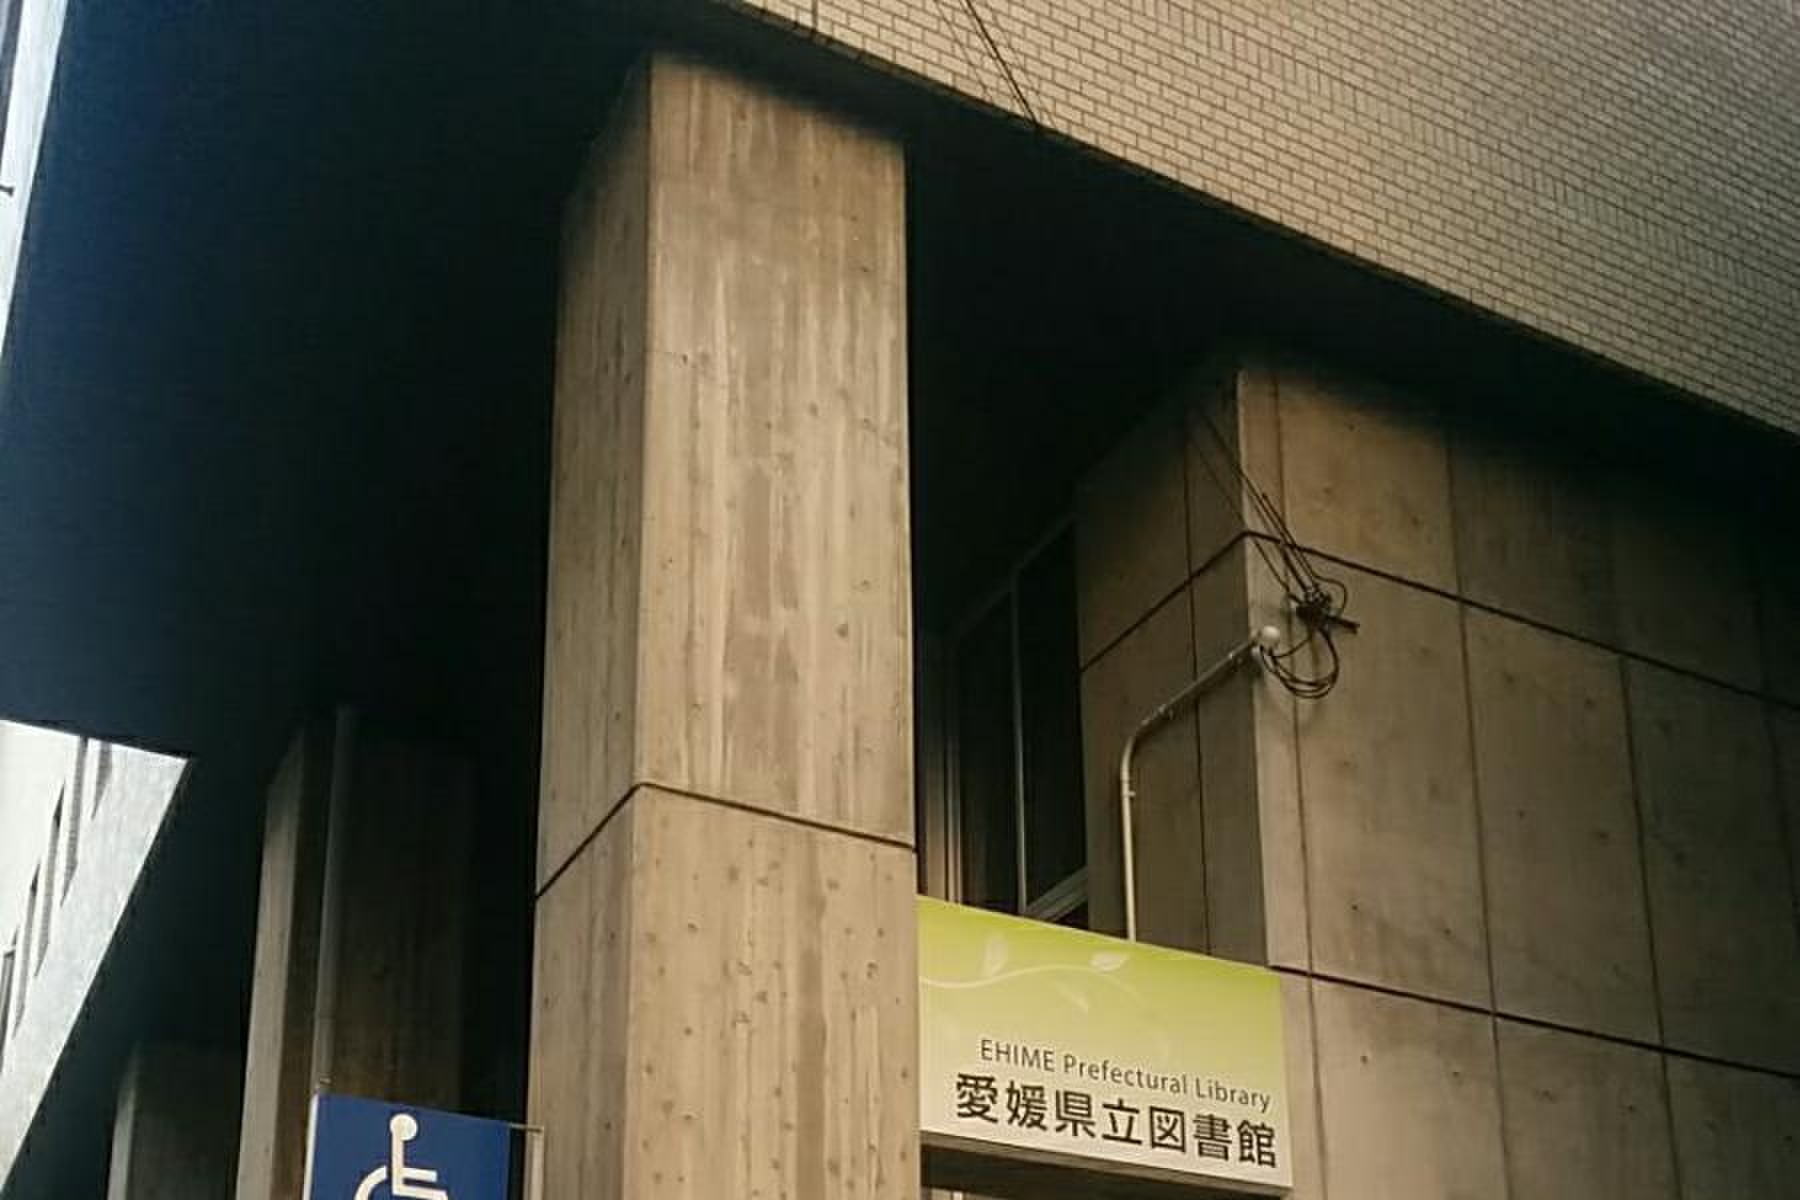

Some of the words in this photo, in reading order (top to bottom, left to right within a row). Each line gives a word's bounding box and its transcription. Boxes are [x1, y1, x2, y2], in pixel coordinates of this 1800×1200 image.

[980, 1038, 1055, 1073] EHIME
[1063, 1053, 1188, 1095] Prefectural
[1195, 1076, 1271, 1113] Library
[956, 1072, 1277, 1168] 愛媛県立図書館
